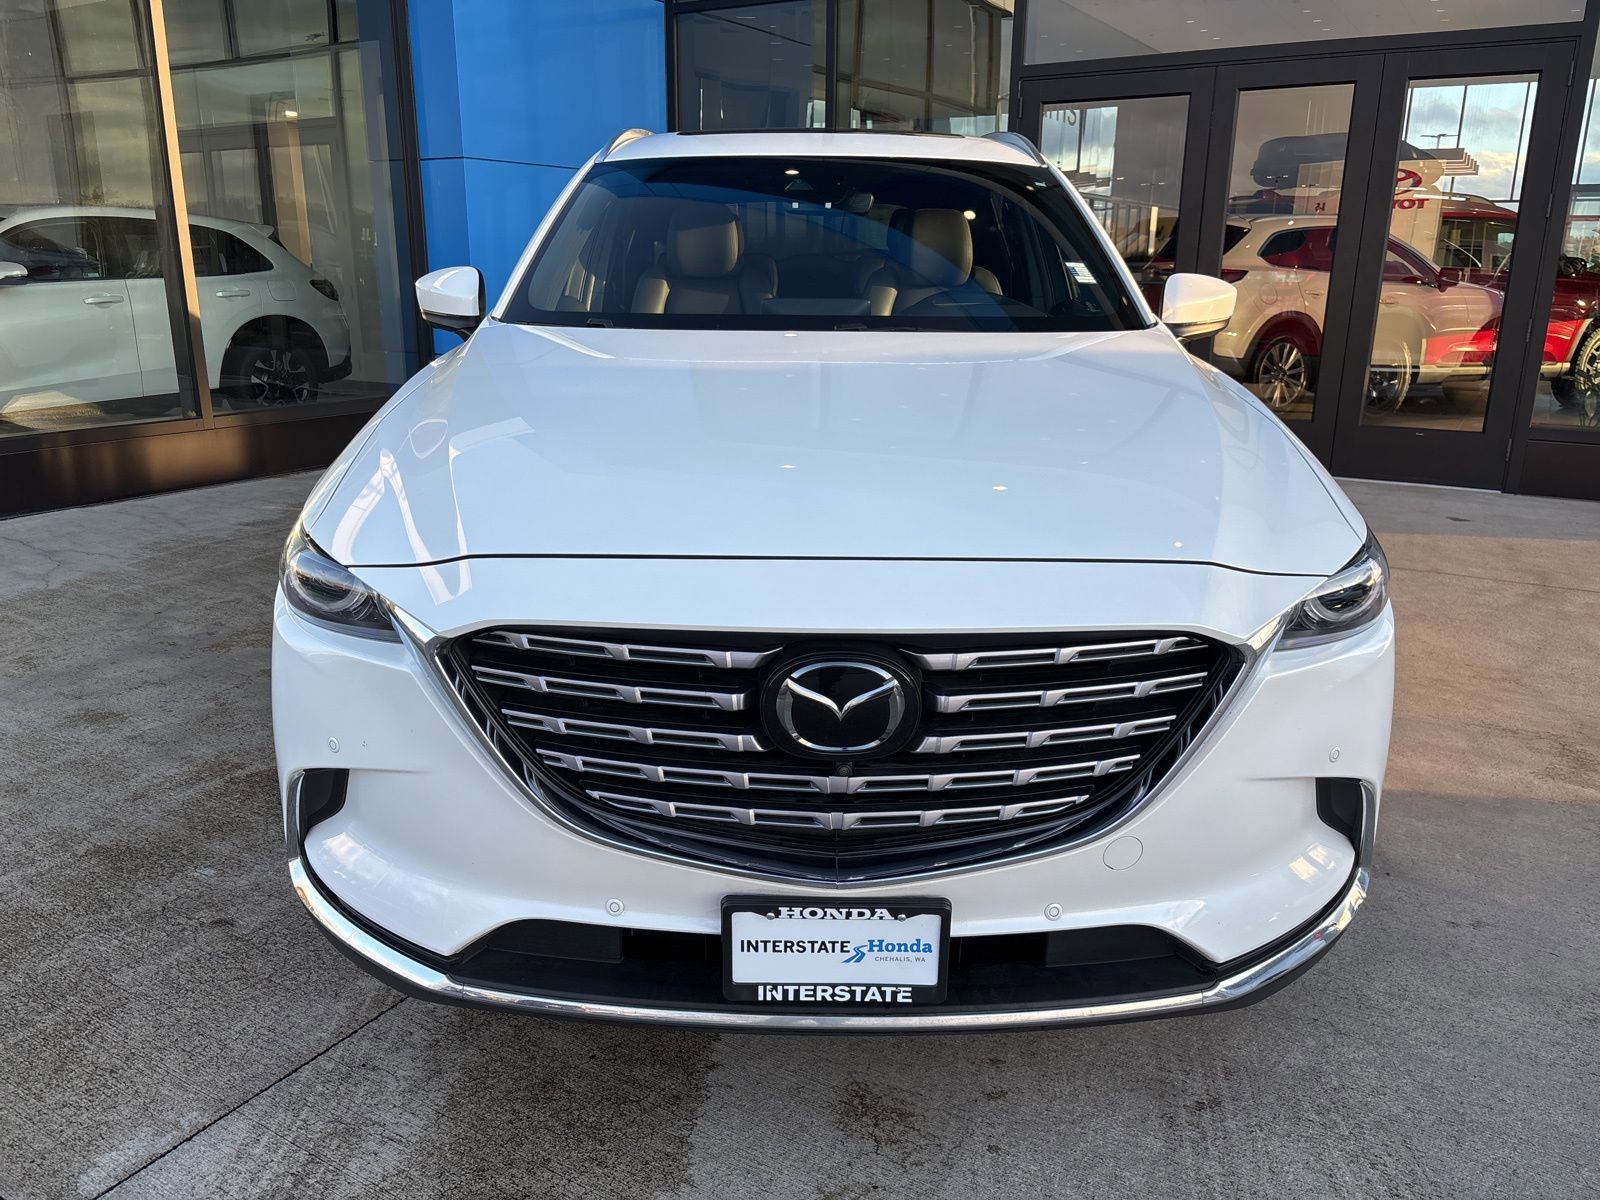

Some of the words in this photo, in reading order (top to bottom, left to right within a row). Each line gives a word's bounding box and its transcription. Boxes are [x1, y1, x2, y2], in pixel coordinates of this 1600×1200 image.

[778, 906, 895, 920] HONDA
[740, 939, 851, 954] INTERSTATE
[867, 938, 933, 953] Honda
[757, 985, 913, 1002] INTERSTATE
